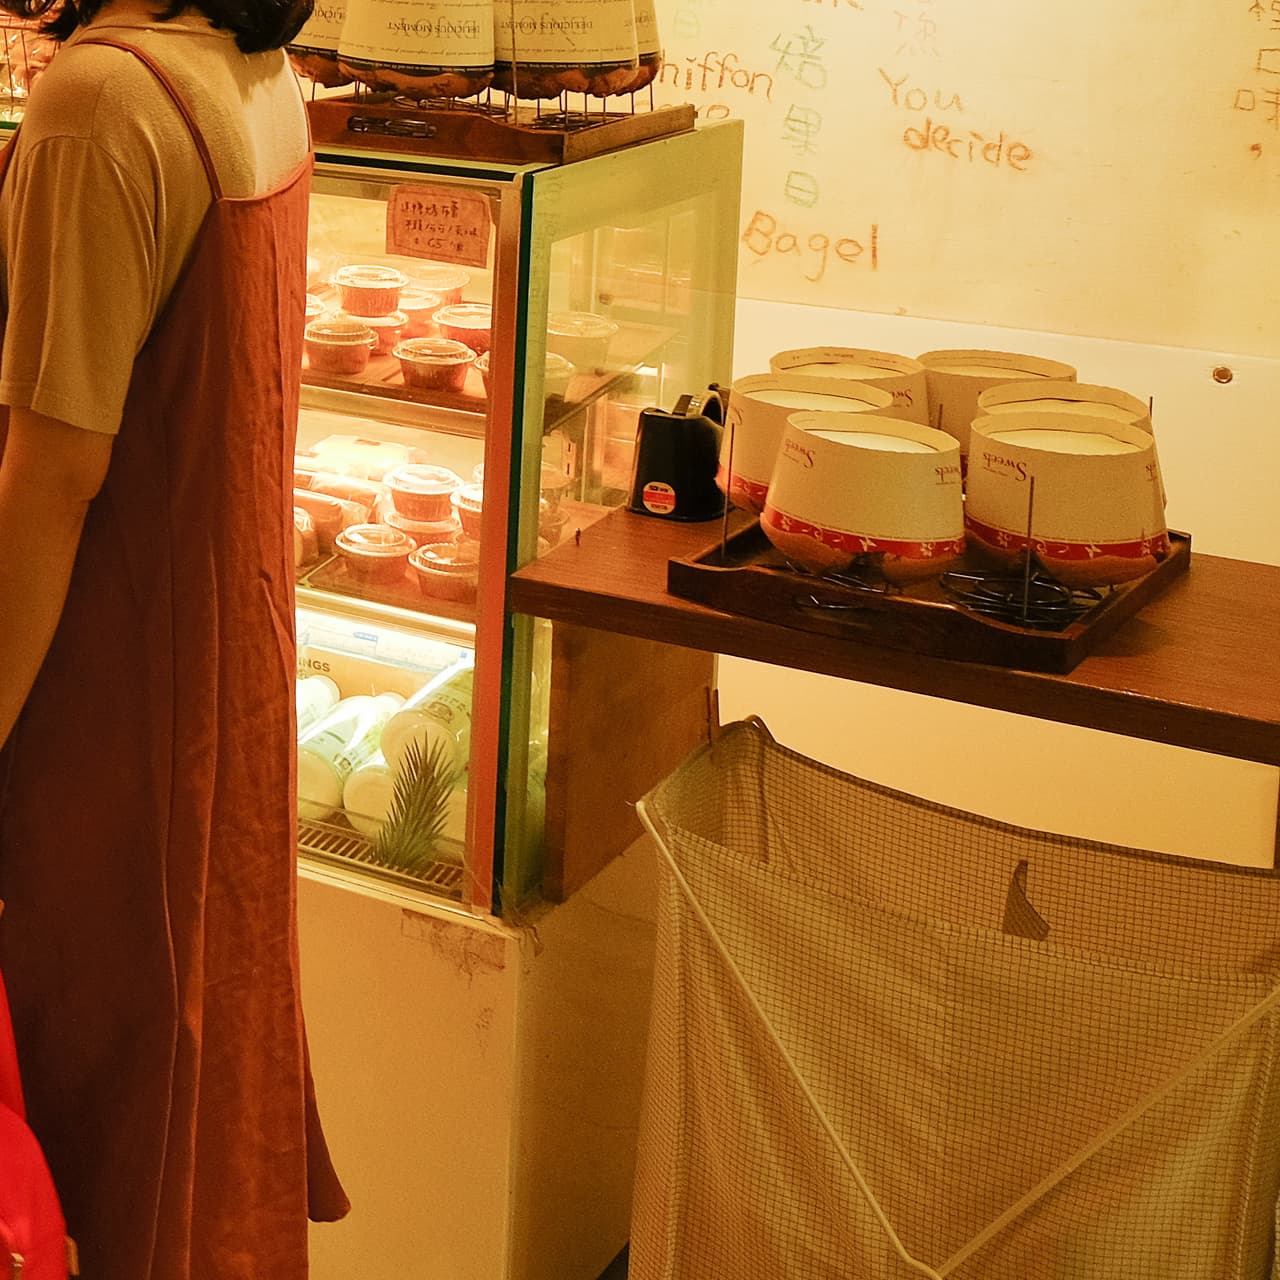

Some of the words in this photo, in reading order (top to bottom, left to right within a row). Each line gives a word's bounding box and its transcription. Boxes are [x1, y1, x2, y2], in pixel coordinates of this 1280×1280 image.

[658, 47, 774, 104] hiffon
[876, 66, 966, 114] You
[903, 115, 1035, 172] decide
[742, 209, 880, 283] Bagel
[982, 451, 1027, 481] Sweets
